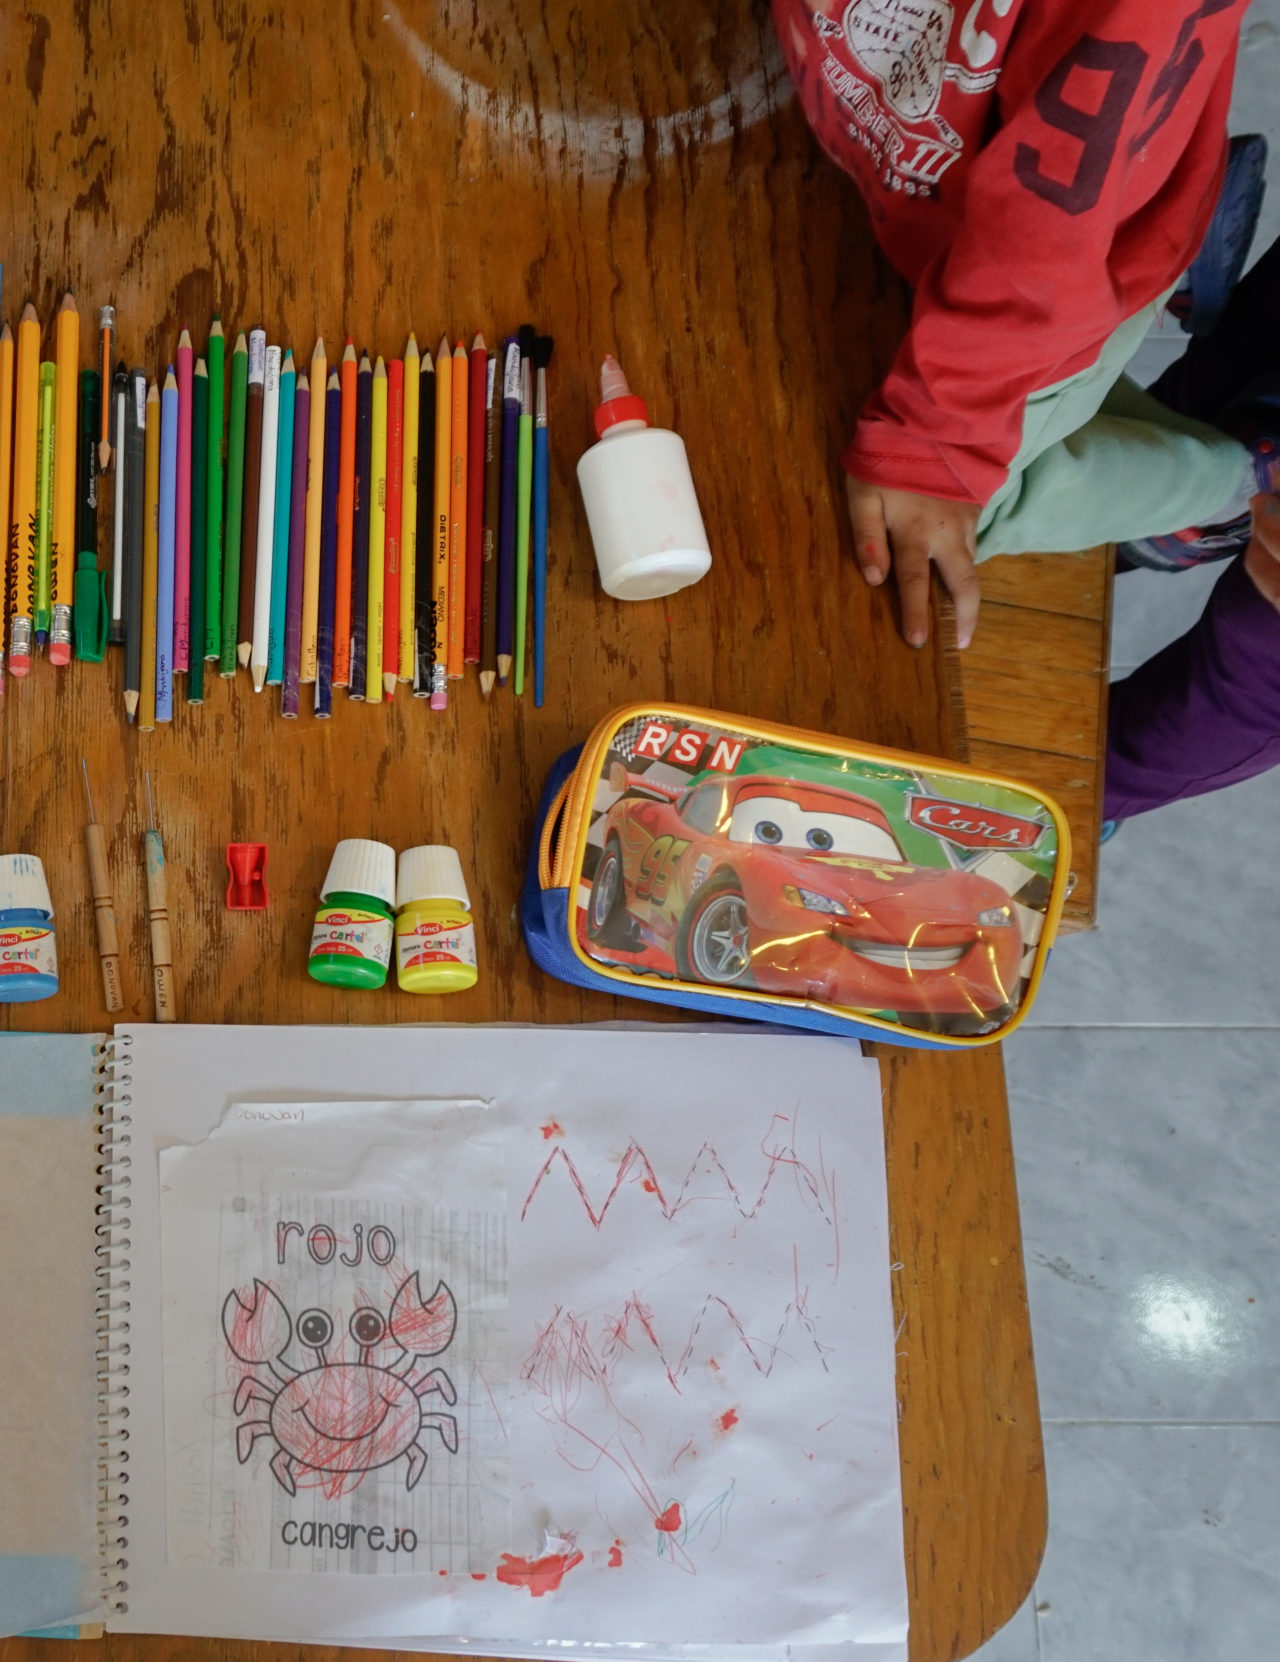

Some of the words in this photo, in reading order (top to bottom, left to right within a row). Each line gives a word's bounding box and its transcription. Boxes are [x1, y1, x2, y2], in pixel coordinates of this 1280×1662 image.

[917, 804, 1023, 848] Cars
[636, 834, 693, 907] 95
[326, 916, 349, 925] Vinci
[416, 924, 441, 934] Vinci
[155, 968, 168, 1009] OWEN
[276, 1218, 397, 1267] rojo
[281, 1515, 419, 1554] cangrejo
